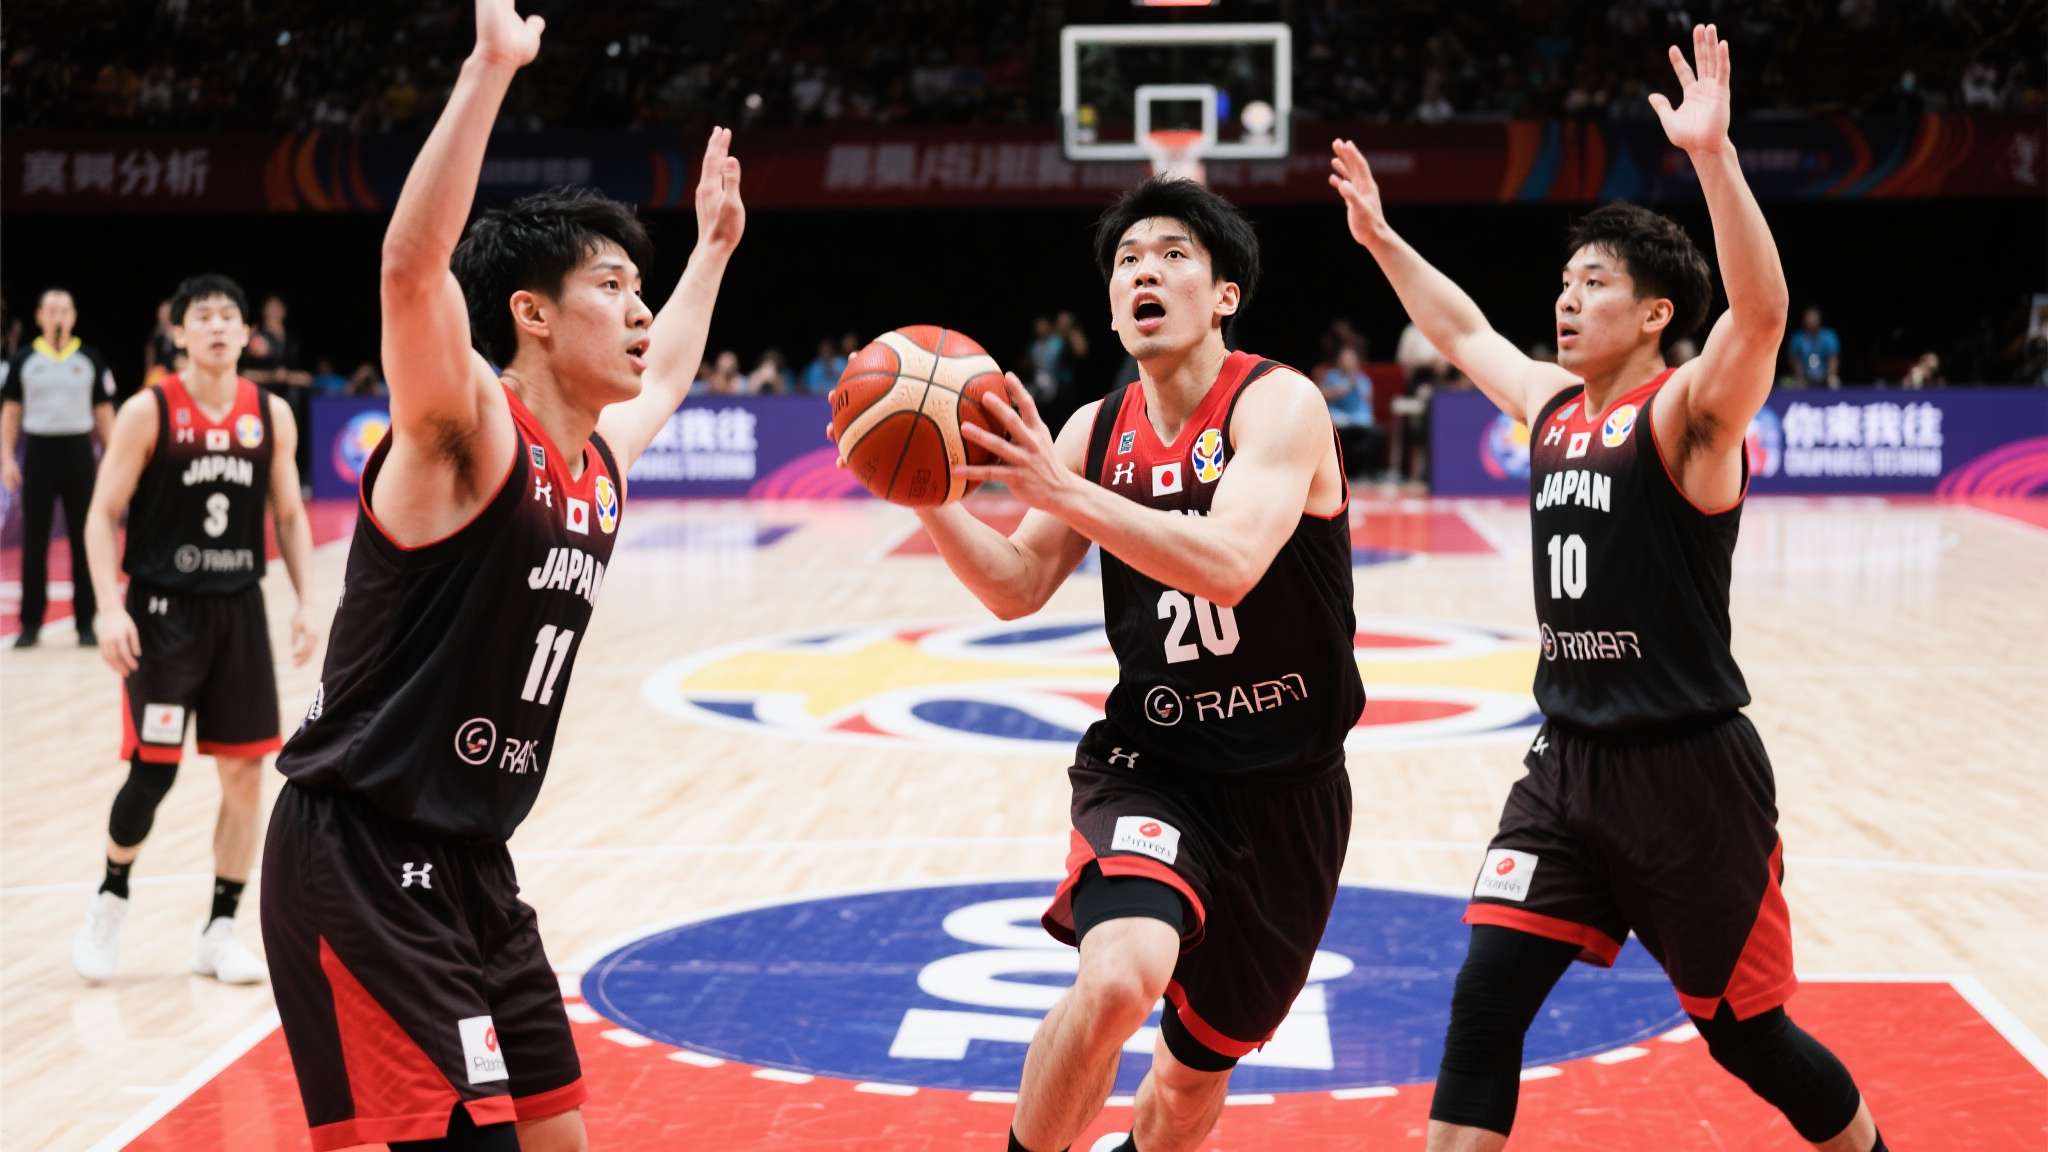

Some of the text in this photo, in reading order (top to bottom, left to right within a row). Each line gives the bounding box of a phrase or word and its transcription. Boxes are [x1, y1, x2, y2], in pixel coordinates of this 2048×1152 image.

[183, 455, 253, 487] JAPAN
[1536, 469, 1611, 513] JAPAN
[203, 492, 230, 538] 3
[528, 548, 605, 607] JAPAN
[1547, 534, 1587, 600] 10
[1157, 590, 1240, 664] 20
[521, 624, 575, 706] 11
